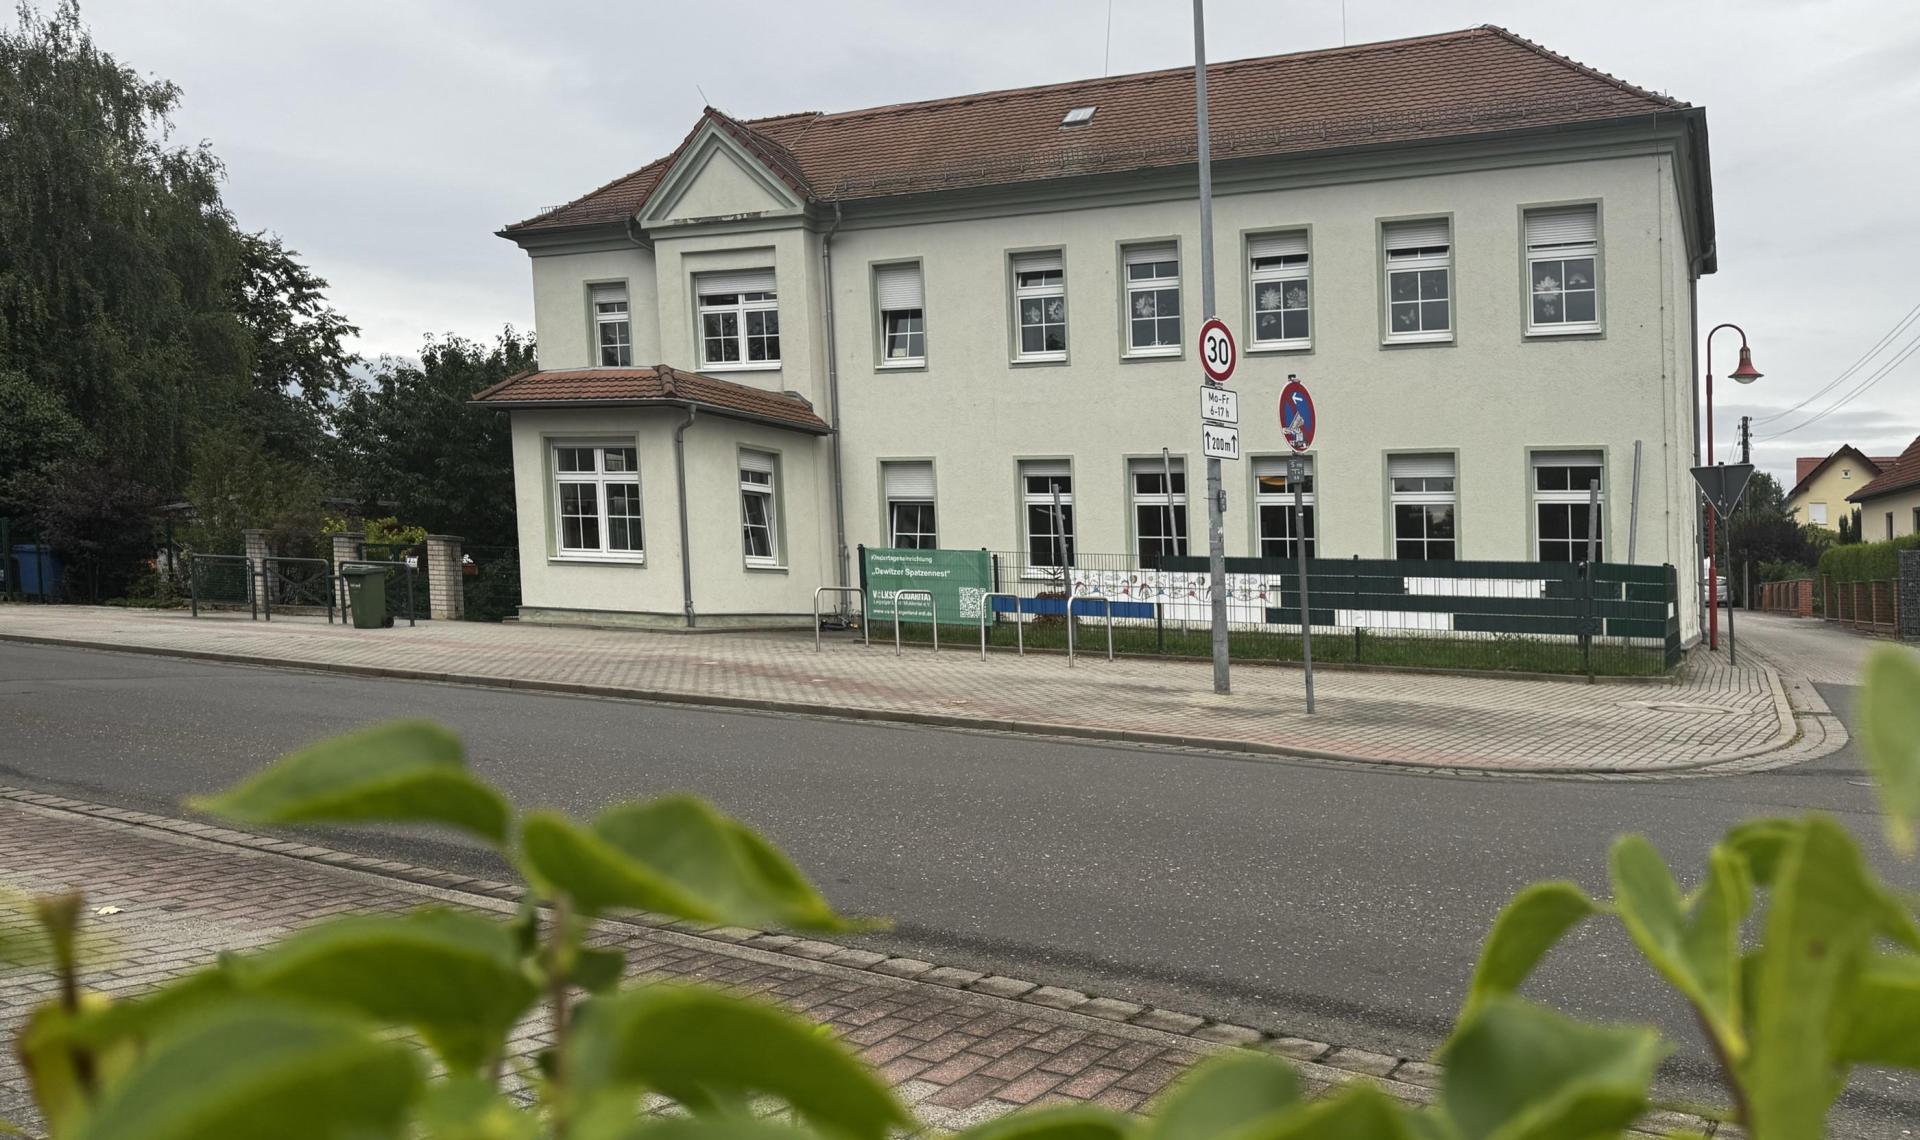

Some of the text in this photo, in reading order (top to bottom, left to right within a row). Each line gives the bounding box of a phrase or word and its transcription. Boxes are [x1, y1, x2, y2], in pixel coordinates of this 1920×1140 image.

[1207, 336, 1228, 365] 30
[1208, 392, 1229, 404] Mo-Fr
[1210, 406, 1224, 416] 6-17
